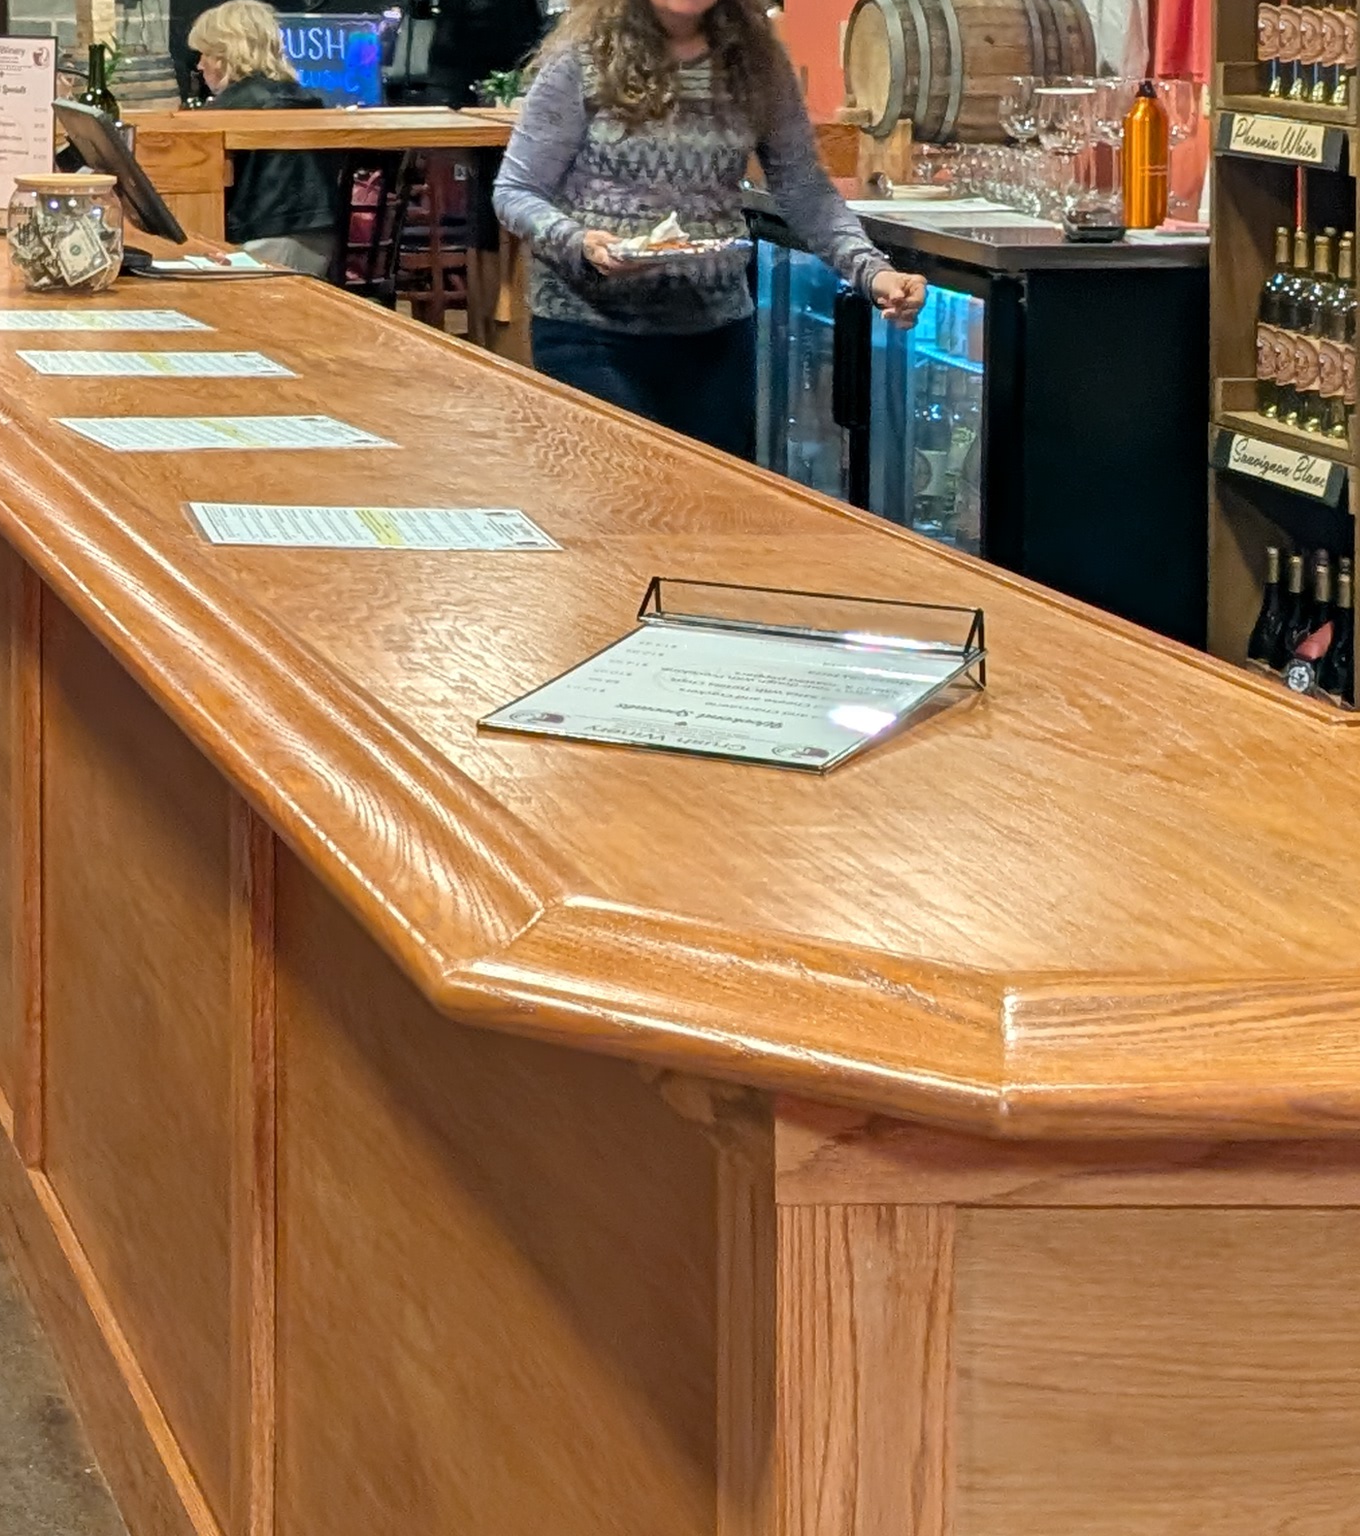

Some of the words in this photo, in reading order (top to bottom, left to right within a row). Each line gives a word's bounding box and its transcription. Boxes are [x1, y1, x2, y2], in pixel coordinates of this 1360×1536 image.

[0, 46, 26, 57] Winery
[1233, 117, 1280, 152] Phoenix
[1281, 126, 1318, 159] White
[1233, 438, 1292, 476] Sauvignon
[1292, 455, 1326, 488] Blanc
[584, 724, 665, 741] Winery
[676, 736, 747, 752] Crush
